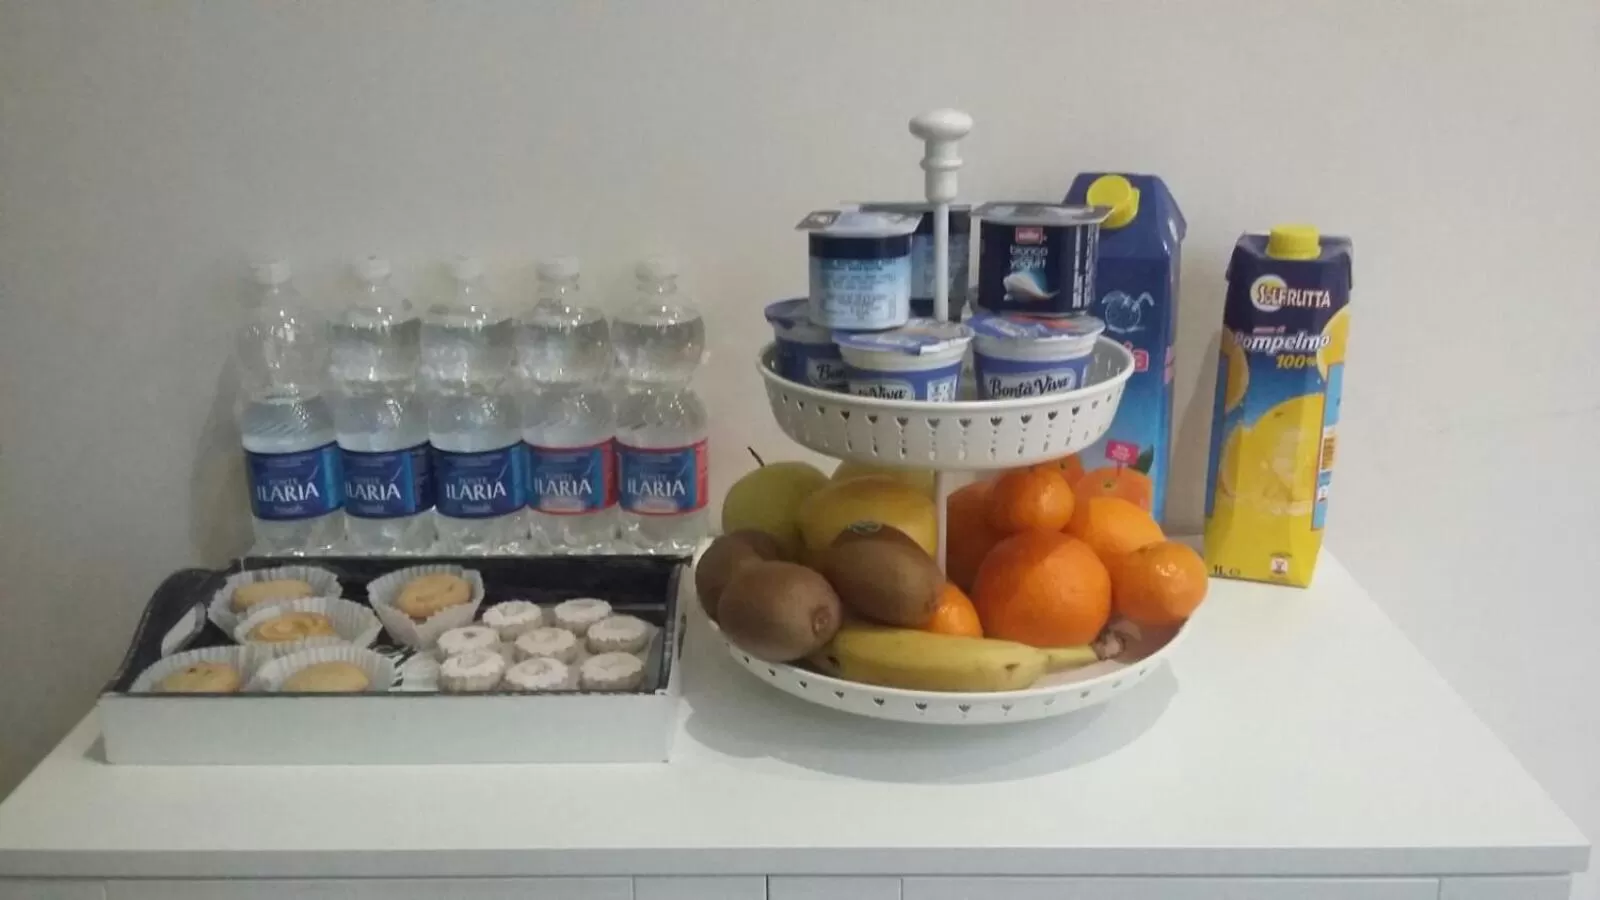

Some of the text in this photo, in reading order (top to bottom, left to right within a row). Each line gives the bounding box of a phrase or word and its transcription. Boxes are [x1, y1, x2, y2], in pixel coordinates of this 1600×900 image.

[1234, 331, 1331, 354] Pompelmo
[256, 481, 320, 502] ILARIA
[344, 481, 402, 501] ILARIA
[445, 481, 507, 501] ILARIA
[533, 478, 593, 497] ILARIA
[627, 478, 686, 497] ILARIA
